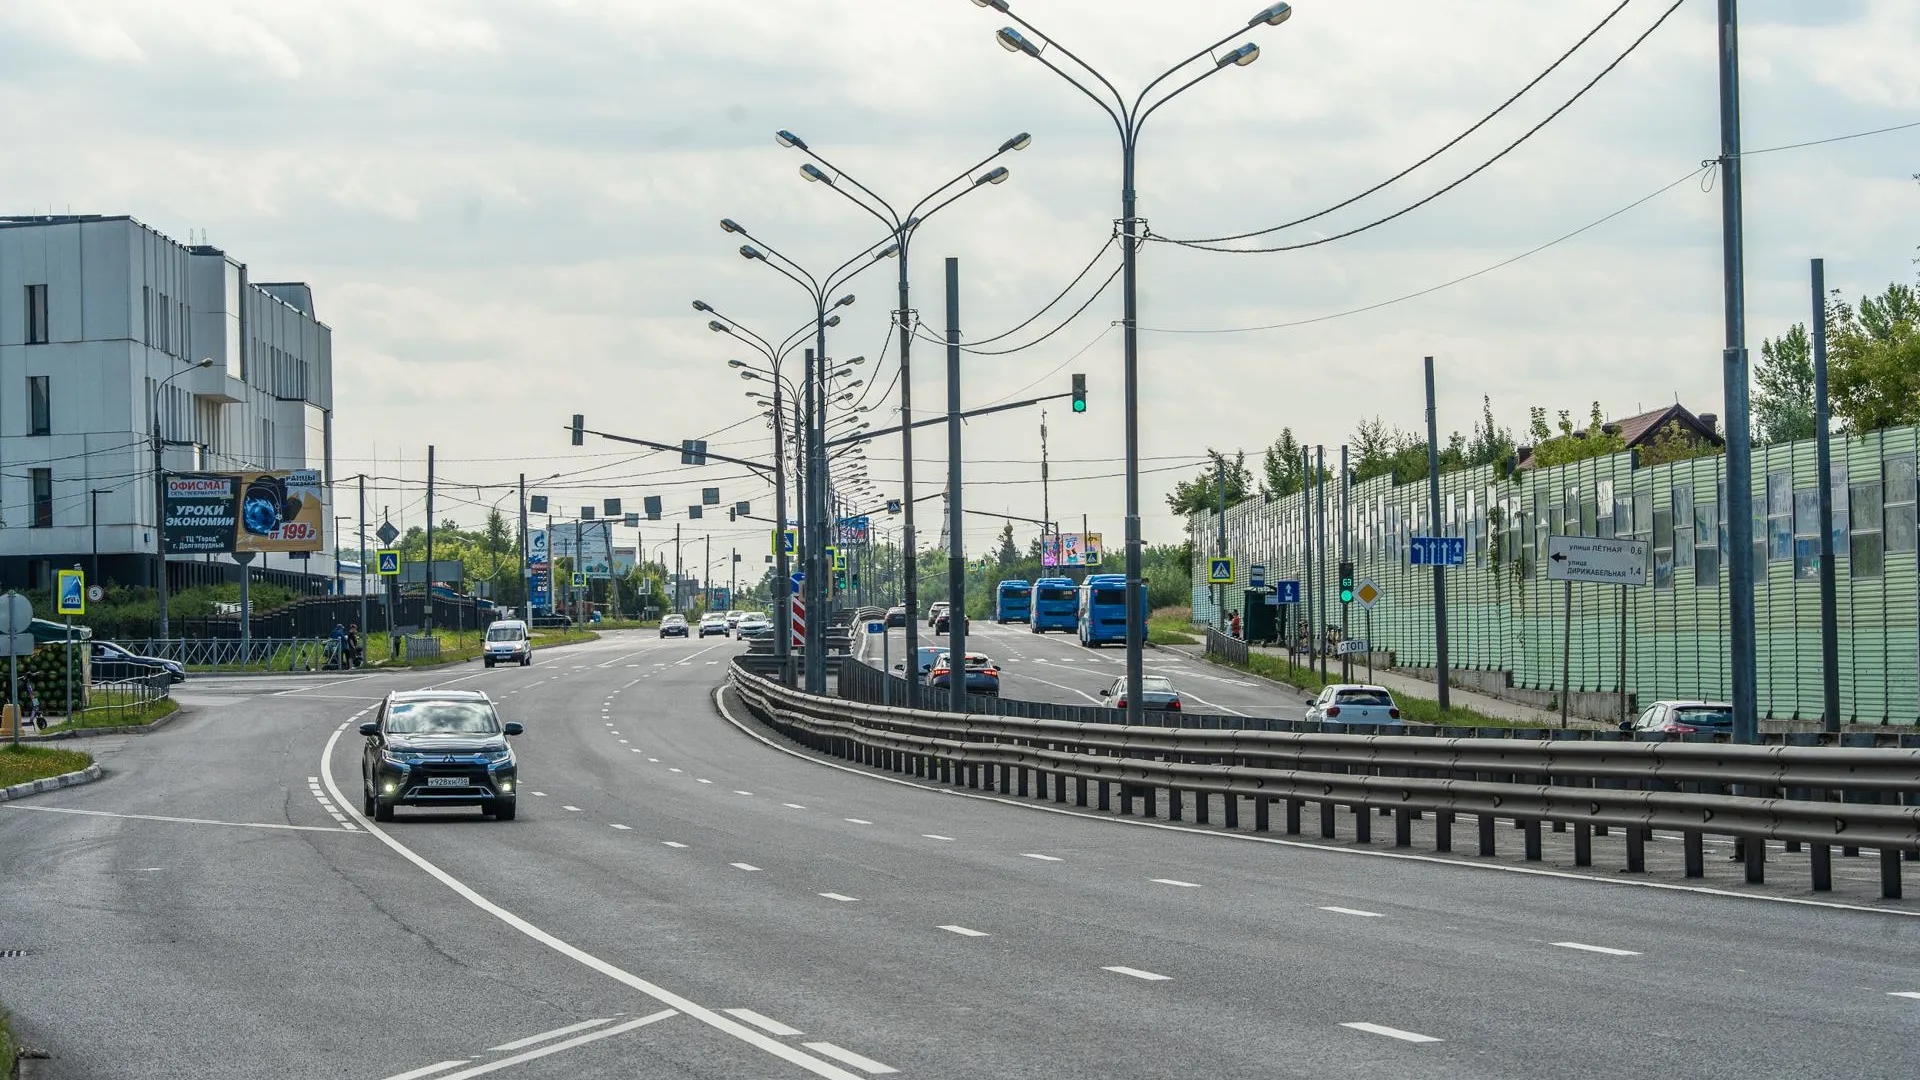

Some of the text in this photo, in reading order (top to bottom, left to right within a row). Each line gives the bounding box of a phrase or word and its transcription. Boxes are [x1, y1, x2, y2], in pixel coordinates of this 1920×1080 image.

[170, 481, 229, 491] ОФИСМАГ
[176, 505, 225, 515] УРОКИ
[165, 517, 235, 526] ЭКОНОМИИ
[179, 541, 225, 550] Долгопрудный
[1630, 546, 1642, 555] 0,6
[1567, 567, 1641, 577] ДИРИЖАБЕЛЬНАЯ 1,4
[1342, 578, 1352, 586] 63
[1340, 641, 1364, 652] СТОП
